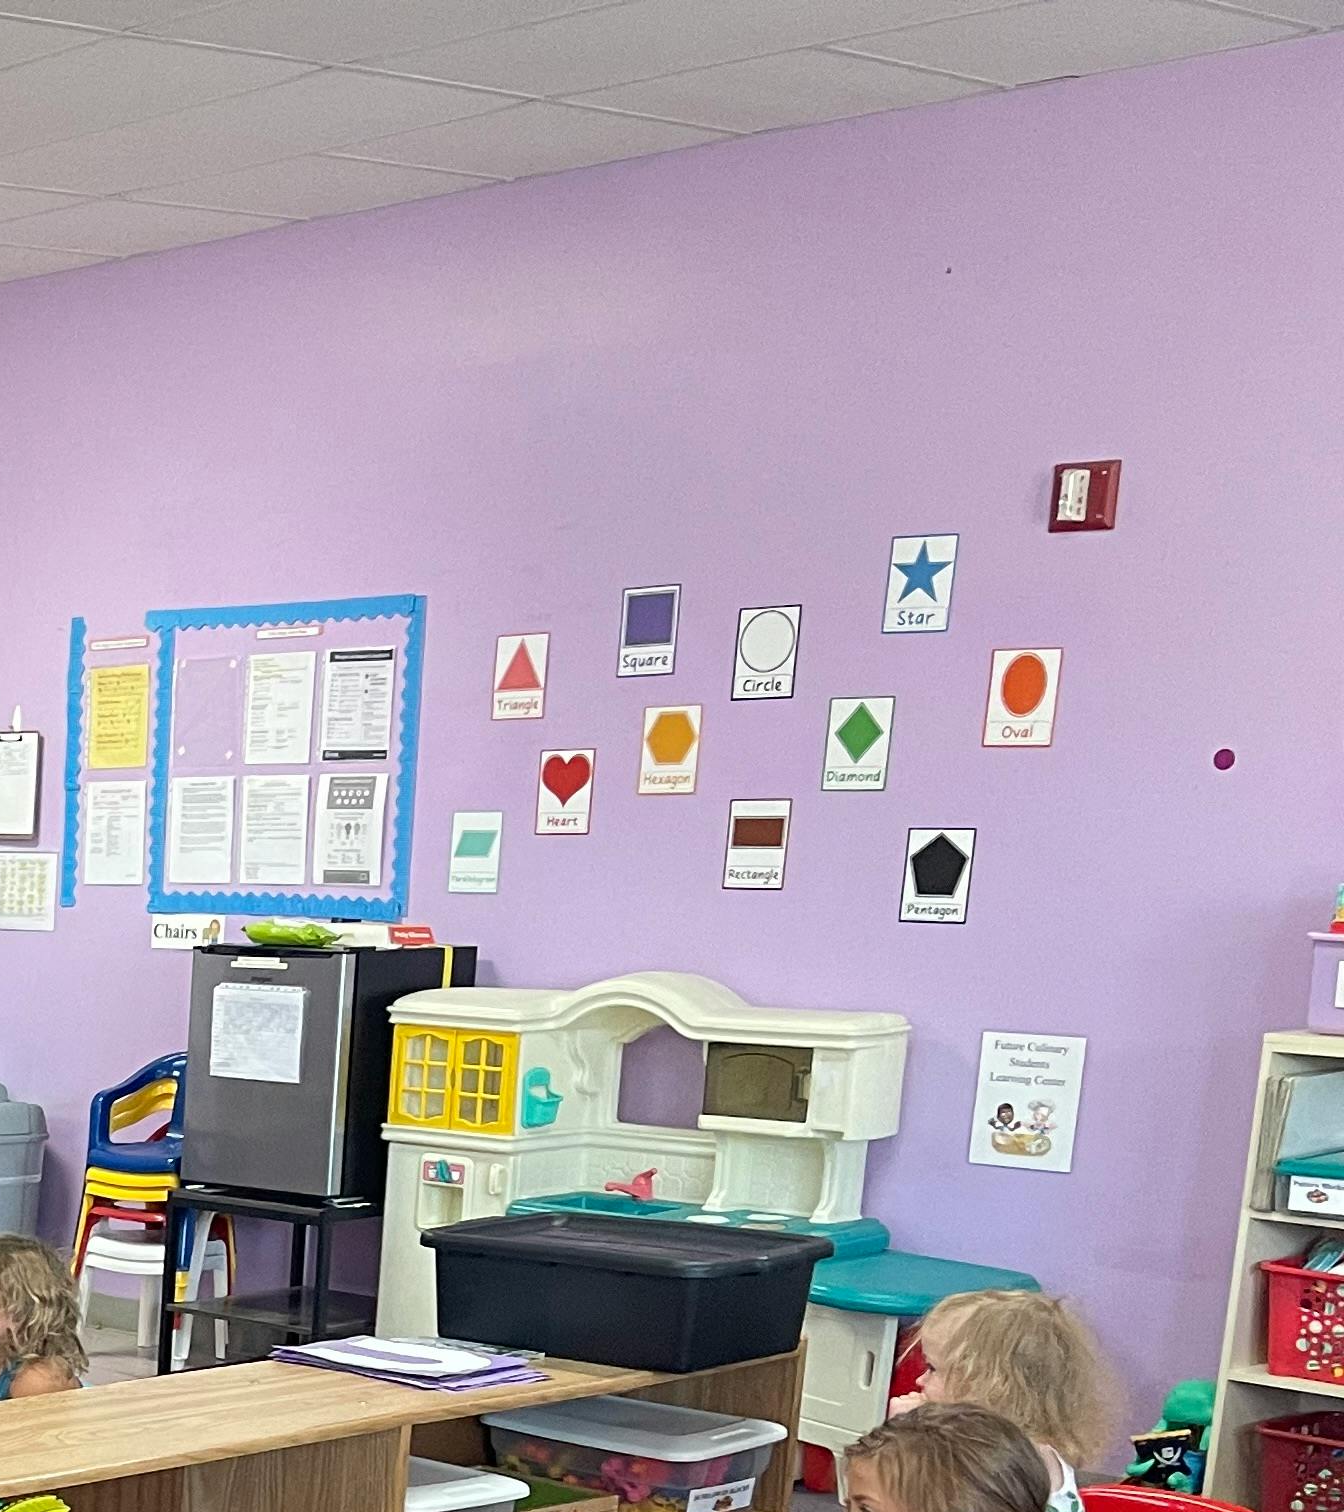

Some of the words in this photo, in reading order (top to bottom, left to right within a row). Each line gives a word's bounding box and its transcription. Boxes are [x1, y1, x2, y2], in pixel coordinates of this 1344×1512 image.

[897, 608, 935, 626] Star
[623, 653, 669, 671] Square
[743, 677, 783, 693] Circle
[497, 697, 539, 714] Triangle
[1002, 724, 1034, 740] Oval
[644, 771, 691, 789] Hexagon
[826, 769, 882, 784] Diamond
[546, 815, 579, 827] Heart
[728, 869, 779, 883] Rectangle
[906, 904, 959, 919] Pentagon
[154, 923, 197, 939] Chairs
[995, 1040, 1025, 1051] Future
[1028, 1042, 1069, 1056] Culinary
[1009, 1058, 1050, 1069] Students
[990, 1072, 1032, 1086] Learning
[1034, 1076, 1066, 1087] Center
